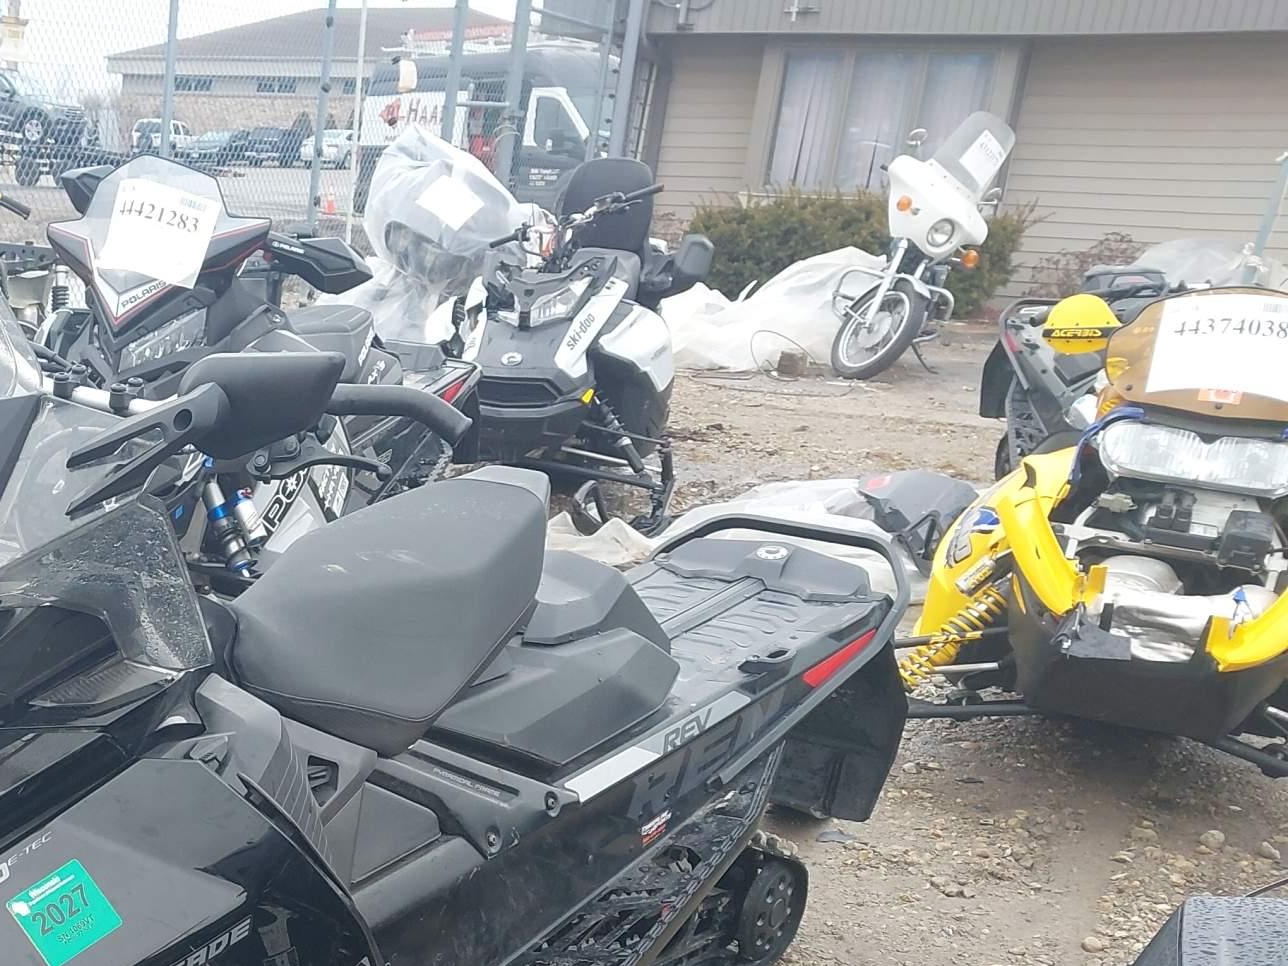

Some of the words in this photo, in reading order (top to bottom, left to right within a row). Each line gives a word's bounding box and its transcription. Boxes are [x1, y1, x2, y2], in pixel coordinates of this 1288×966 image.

[121, 280, 167, 308] POLARIS
[663, 708, 713, 752] REV
[31, 883, 89, 936] 2027
